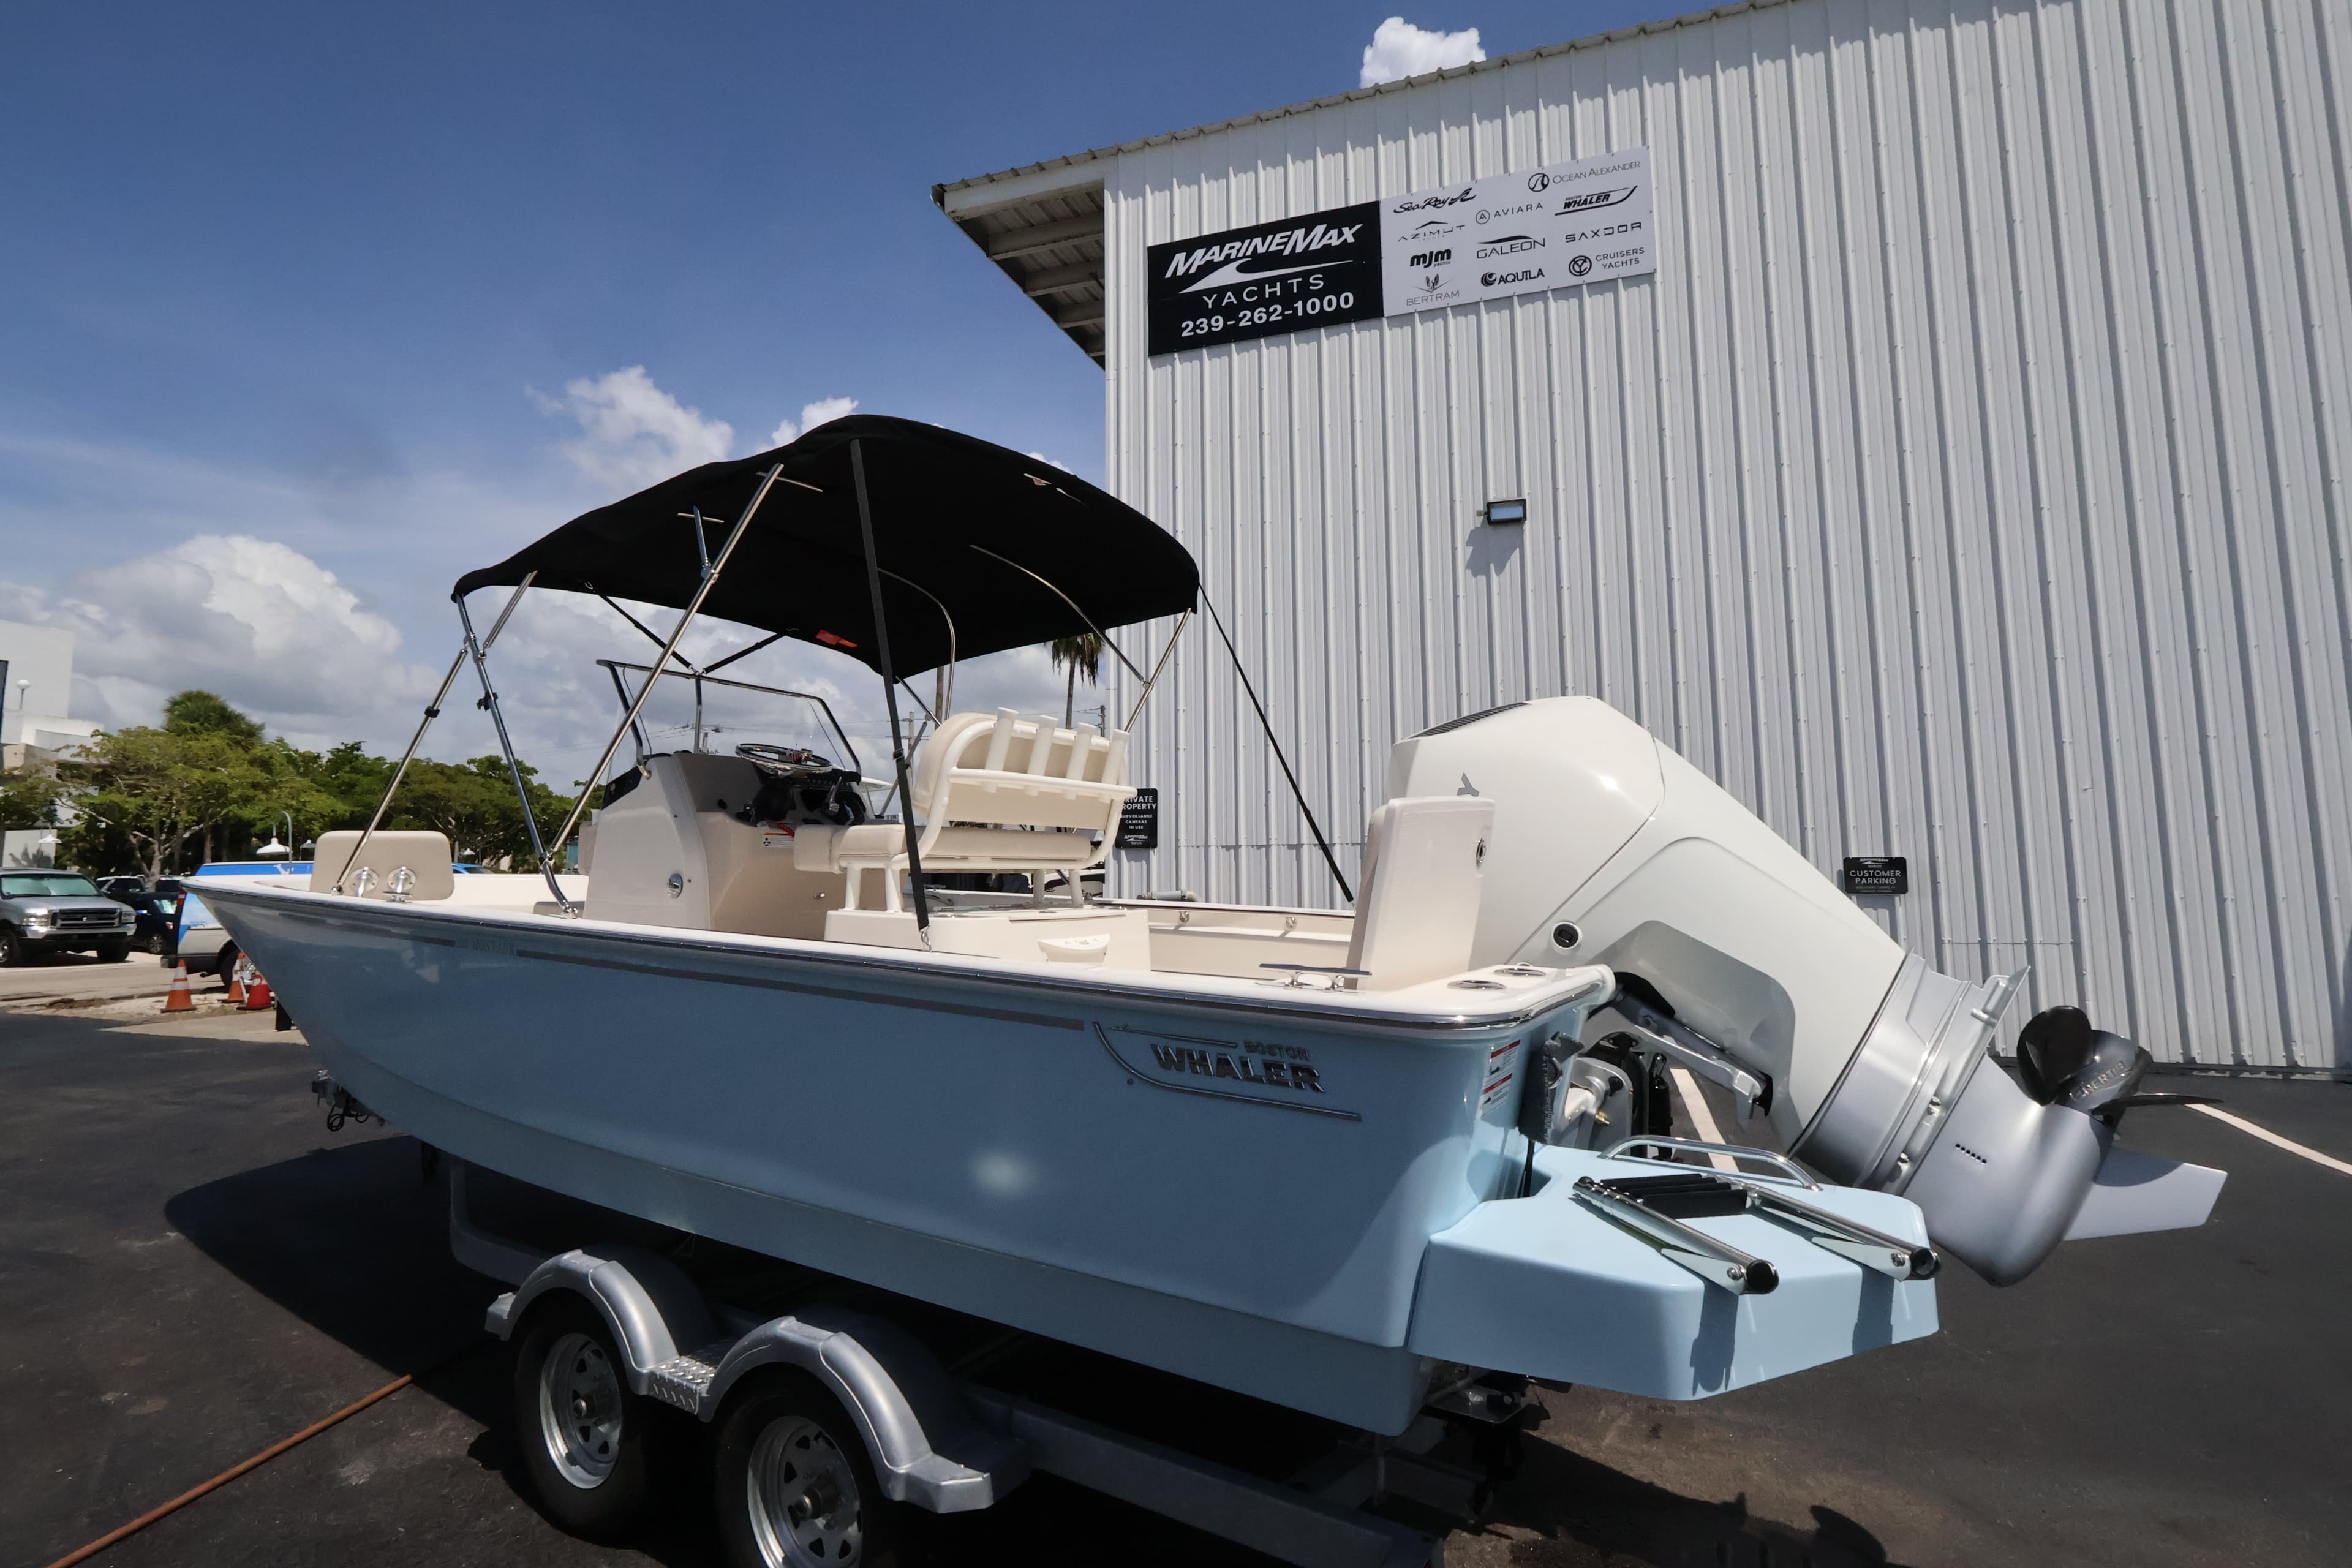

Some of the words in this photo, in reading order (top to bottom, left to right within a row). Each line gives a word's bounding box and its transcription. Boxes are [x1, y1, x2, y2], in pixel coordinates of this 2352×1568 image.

[1552, 172, 1586, 184] OCEAN
[1588, 161, 1641, 178] ALEXANDER
[1393, 202, 1422, 213] Sea
[1420, 197, 1450, 209] Ray
[1494, 202, 1544, 218] AVIARA
[1563, 194, 1611, 209] WHALER
[1398, 225, 1465, 242] AZIMUT
[1566, 222, 1642, 243] SAXDOR
[1477, 238, 1545, 259] GALEON
[1595, 247, 1645, 262] CRUISERS
[1602, 257, 1640, 270] YACHTS
[1498, 268, 1545, 285] AQUILA
[1202, 274, 1324, 309] YACHTS
[1406, 290, 1460, 306] BERTRAM
[1181, 292, 1354, 337] 239-262-1000
[1244, 1041, 1310, 1061] BOSTON
[1150, 1044, 1325, 1093] WHALER
